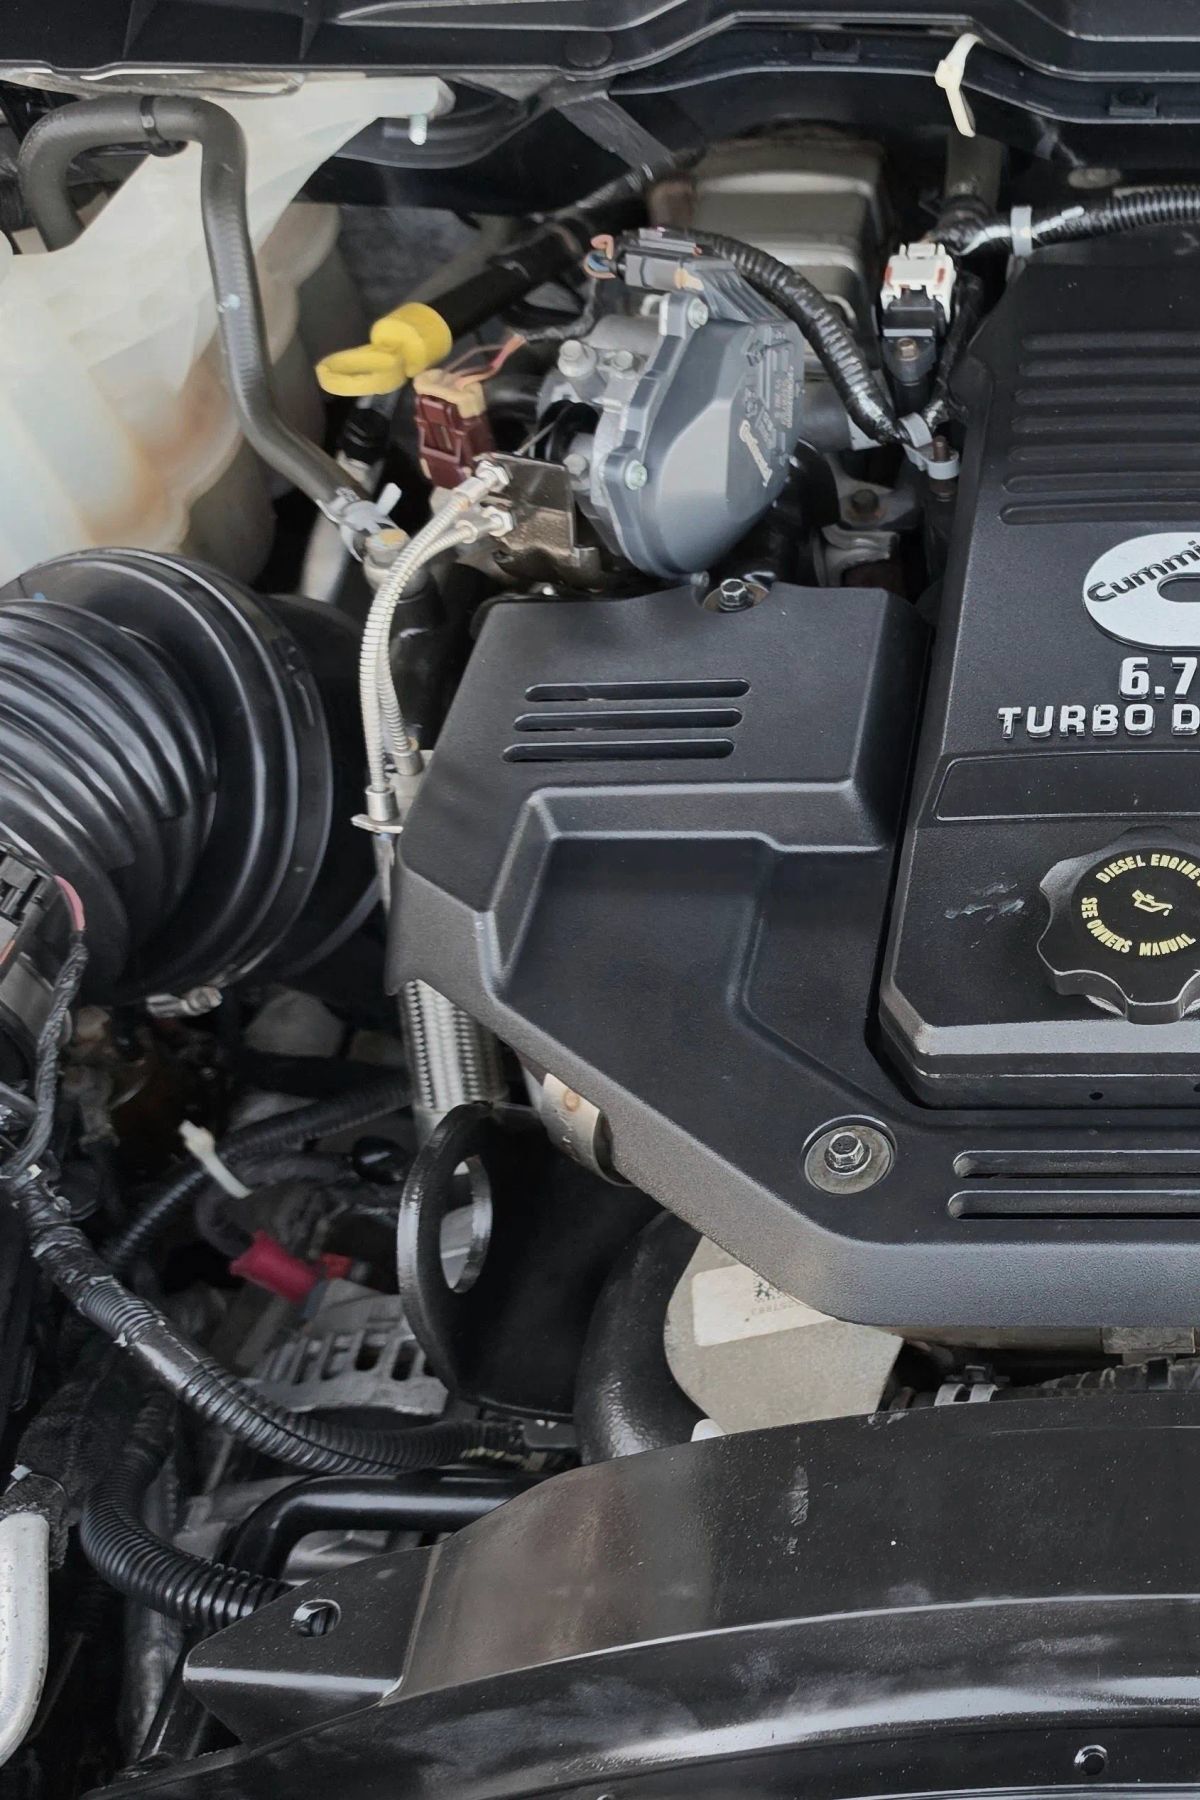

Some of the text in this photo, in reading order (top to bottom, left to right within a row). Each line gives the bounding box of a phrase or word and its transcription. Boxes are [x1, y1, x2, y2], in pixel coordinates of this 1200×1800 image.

[997, 703, 1157, 740] TURBO
[1095, 854, 1147, 884] DIESEL
[1080, 896, 1198, 957] SEE OWNERS MANUAL
